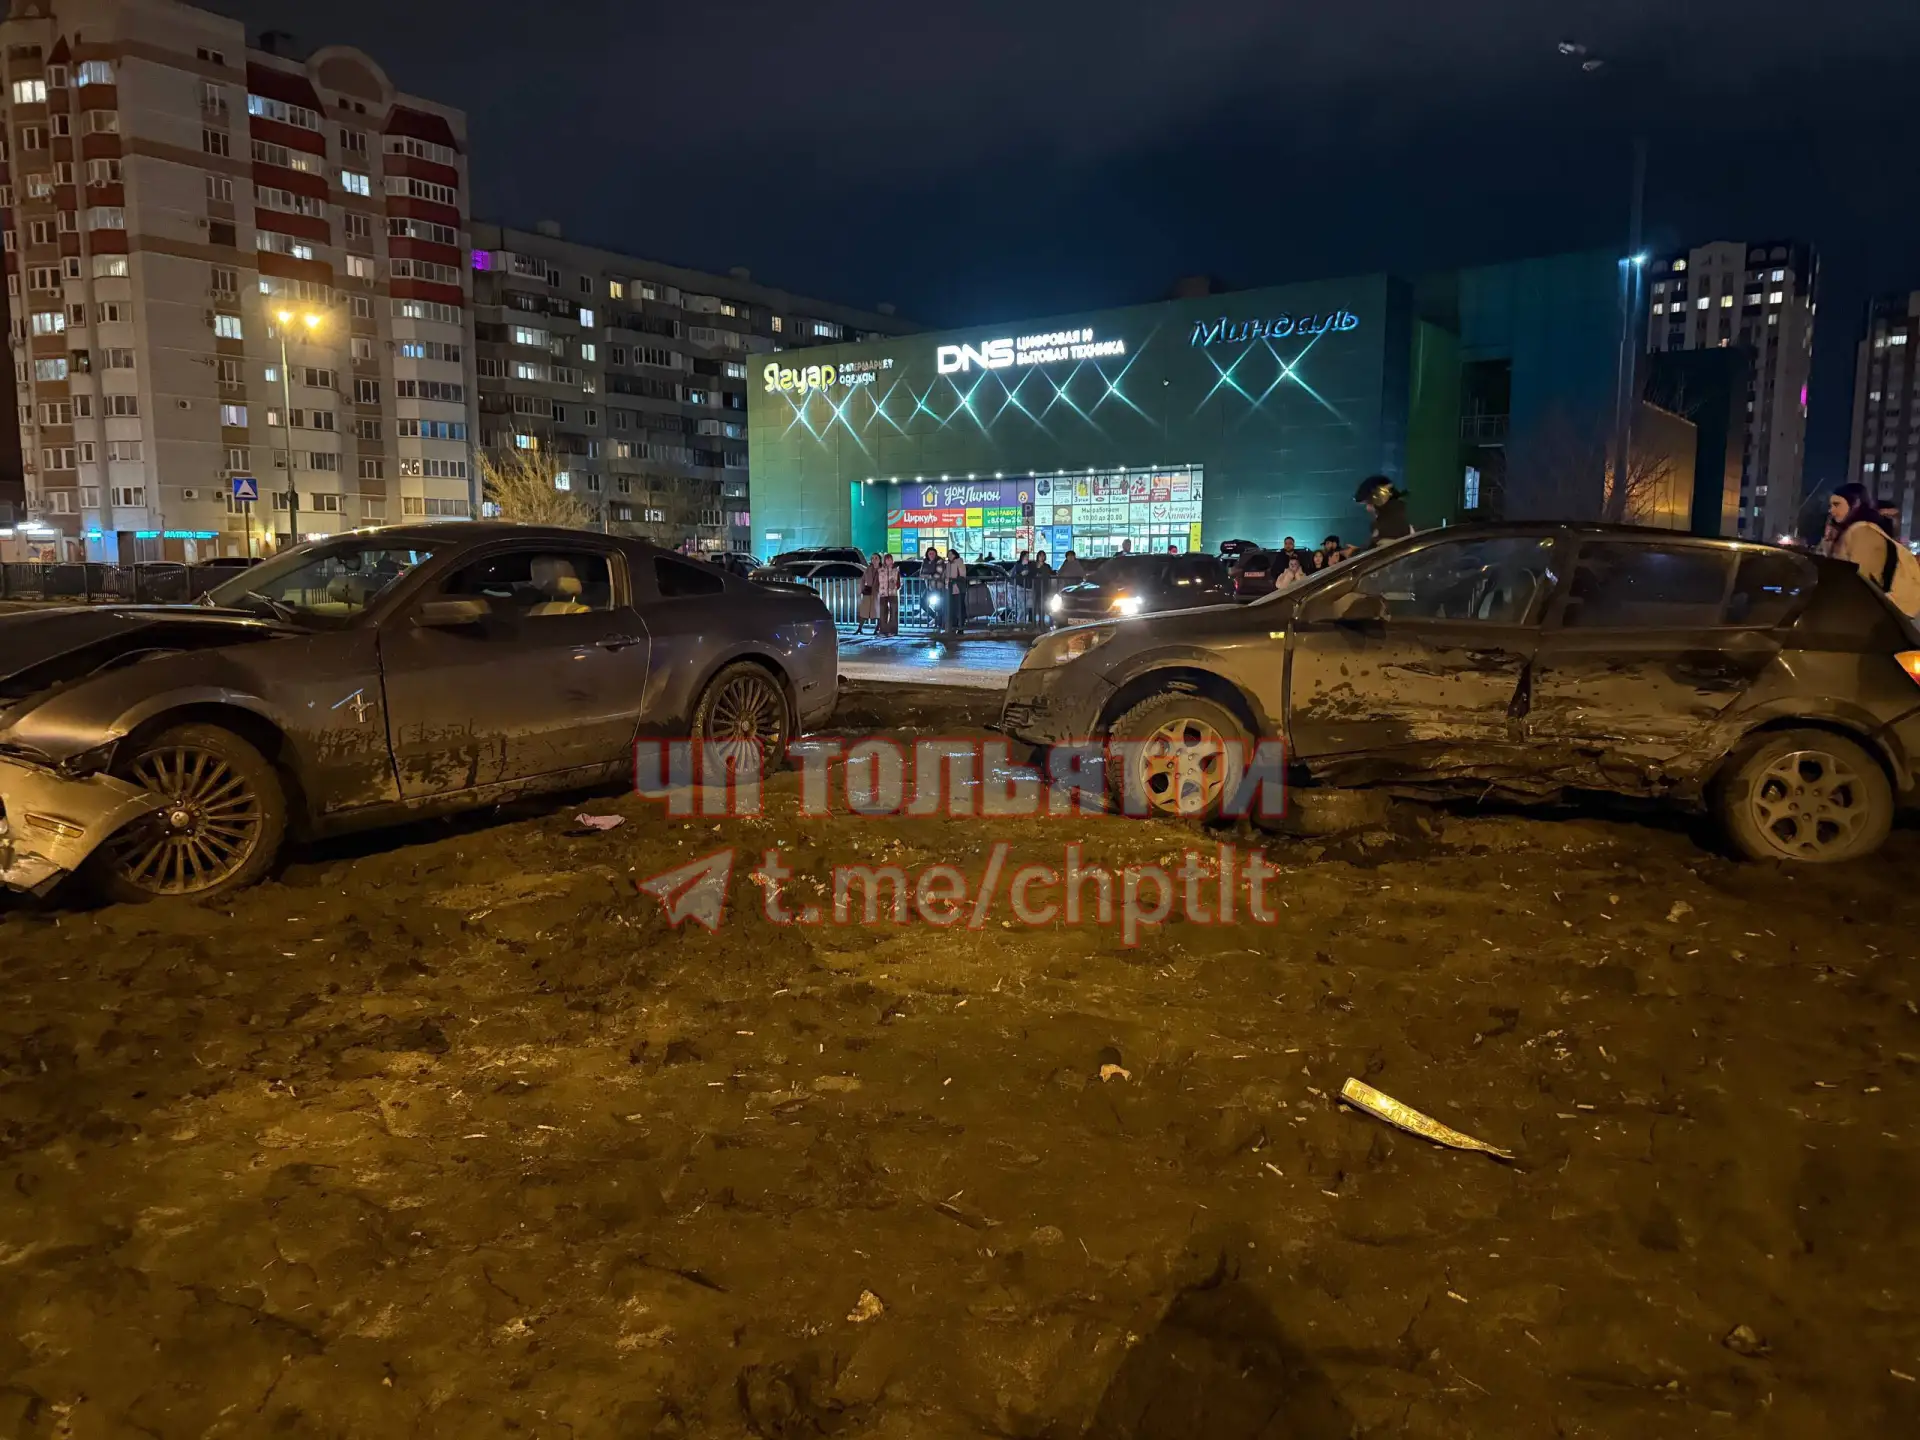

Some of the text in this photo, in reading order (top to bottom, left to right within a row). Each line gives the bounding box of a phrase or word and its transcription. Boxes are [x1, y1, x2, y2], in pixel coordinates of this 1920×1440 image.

[1016, 327, 1094, 351] ЦИФРОВАЯ И
[1190, 310, 1359, 348] Миндаль
[937, 338, 1015, 374] DNS
[1016, 339, 1126, 365] БЫТОВАЯ ТЕХНИКА
[764, 362, 836, 395] Ягуар
